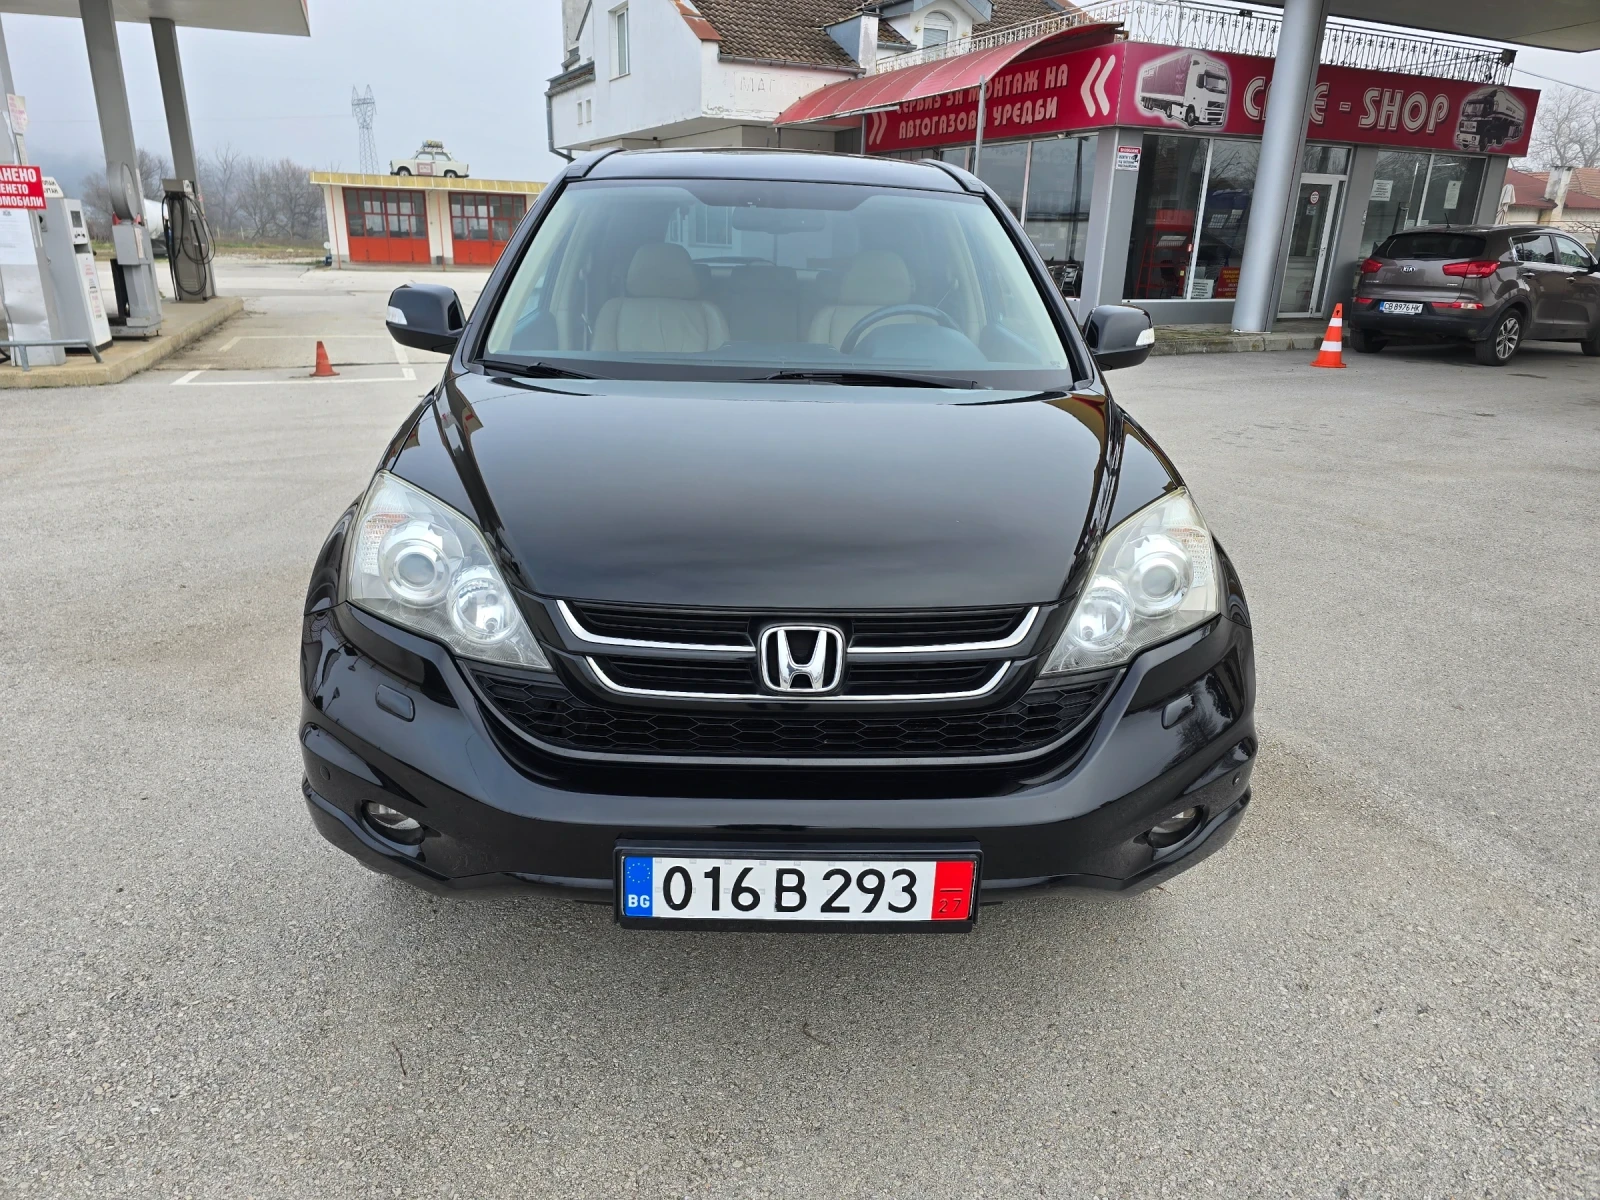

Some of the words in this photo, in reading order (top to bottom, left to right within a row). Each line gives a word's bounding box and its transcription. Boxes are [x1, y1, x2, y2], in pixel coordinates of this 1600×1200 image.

[897, 96, 941, 115] ЕРВИЗ
[1045, 63, 1068, 89] НА
[993, 96, 1058, 126] УРЕДБИ
[1243, 76, 1330, 124] CE
[1358, 87, 1450, 134] SHOP
[0, 183, 29, 195] ЕНЕТО
[0, 196, 44, 207] МОБИЛИ
[1394, 303, 1410, 311] 8976
[662, 865, 761, 912] 016
[774, 867, 807, 913] B
[820, 868, 918, 914] 293
[628, 894, 650, 908] BG
[938, 898, 962, 913] 27
